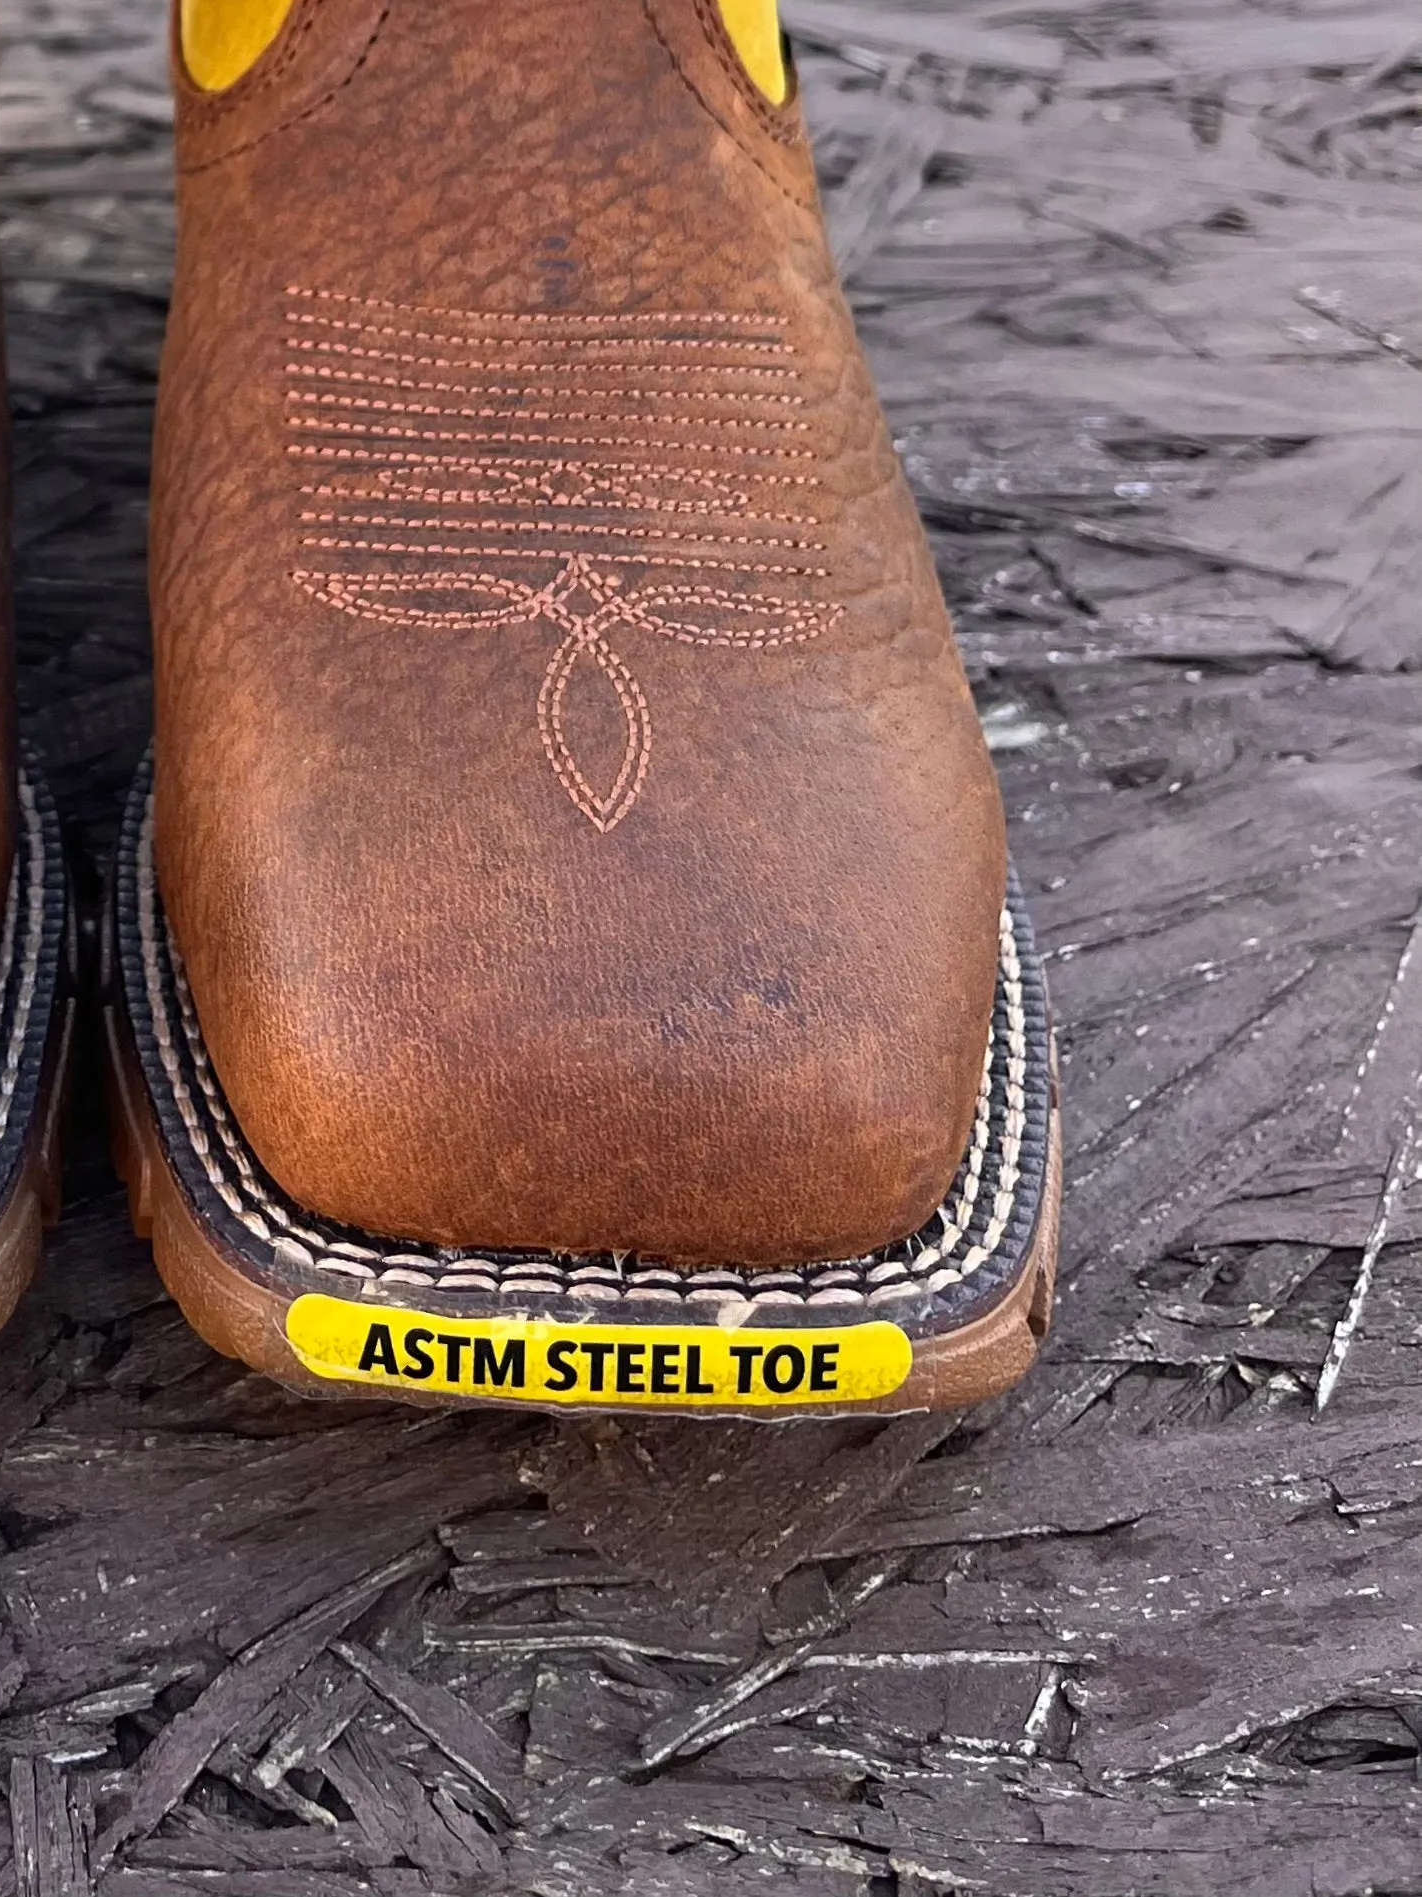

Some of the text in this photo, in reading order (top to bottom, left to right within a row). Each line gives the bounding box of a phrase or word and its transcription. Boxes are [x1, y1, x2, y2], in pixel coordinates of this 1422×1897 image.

[357, 1322, 840, 1394] ASTM STEEL TOE
